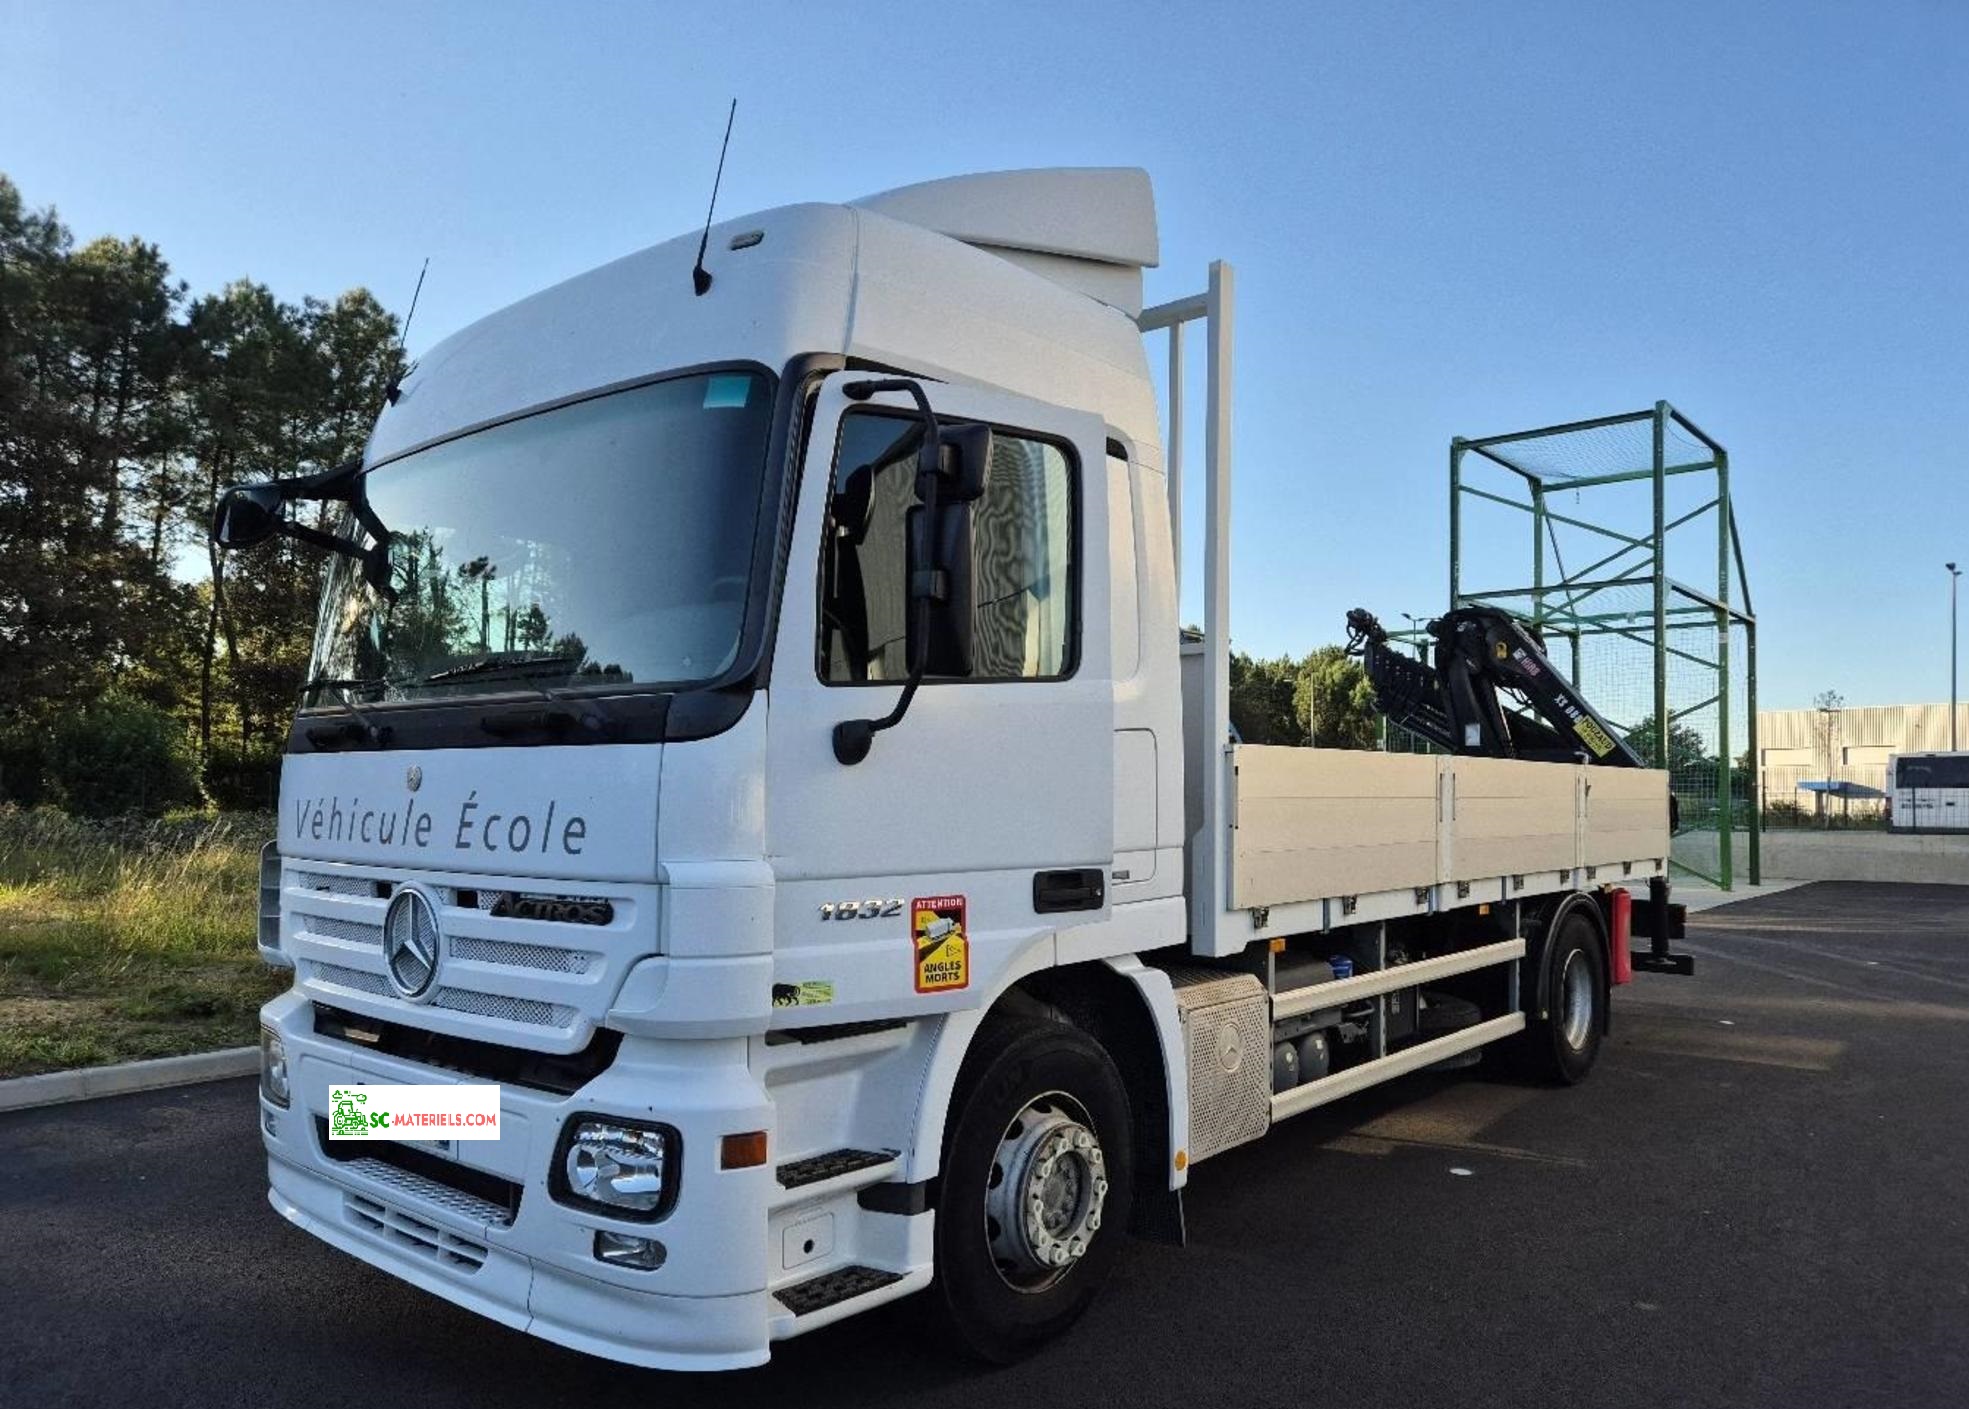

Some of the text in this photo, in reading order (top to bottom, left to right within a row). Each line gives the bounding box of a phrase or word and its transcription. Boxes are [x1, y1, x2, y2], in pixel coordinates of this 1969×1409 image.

[296, 790, 587, 855] Véhicule École
[818, 898, 905, 921] 1832
[916, 898, 963, 910] ATTENTION
[924, 961, 962, 974] ANGLES
[925, 972, 961, 984] MORTS
